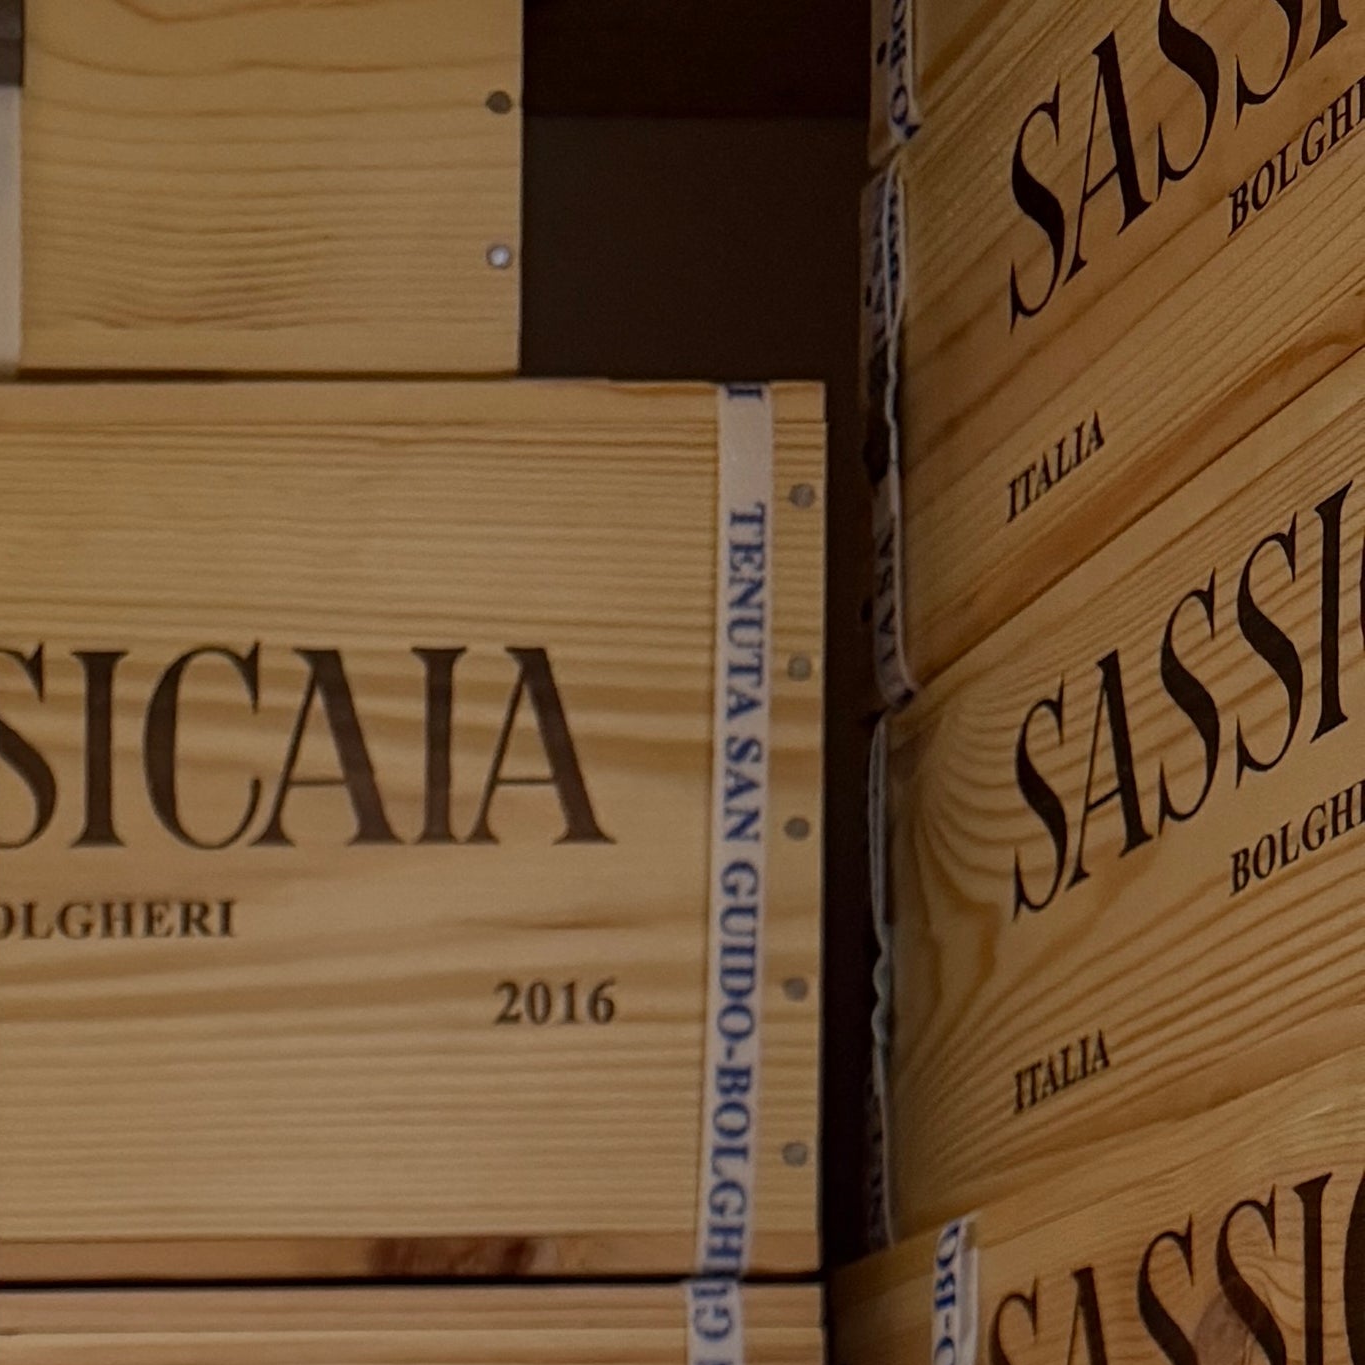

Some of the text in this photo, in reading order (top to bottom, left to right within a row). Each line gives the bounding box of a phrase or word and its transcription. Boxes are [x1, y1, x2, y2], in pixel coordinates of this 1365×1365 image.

[1226, 75, 1365, 238] BOLGH
[1006, 410, 1105, 523] ITALIA
[725, 502, 766, 718] TENUTA
[1013, 480, 1365, 920] SASSI
[723, 737, 764, 842] SAN
[1229, 780, 1365, 897] BOLGH
[494, 978, 617, 1027] 2016
[1013, 1029, 1111, 1115] ITALIA
